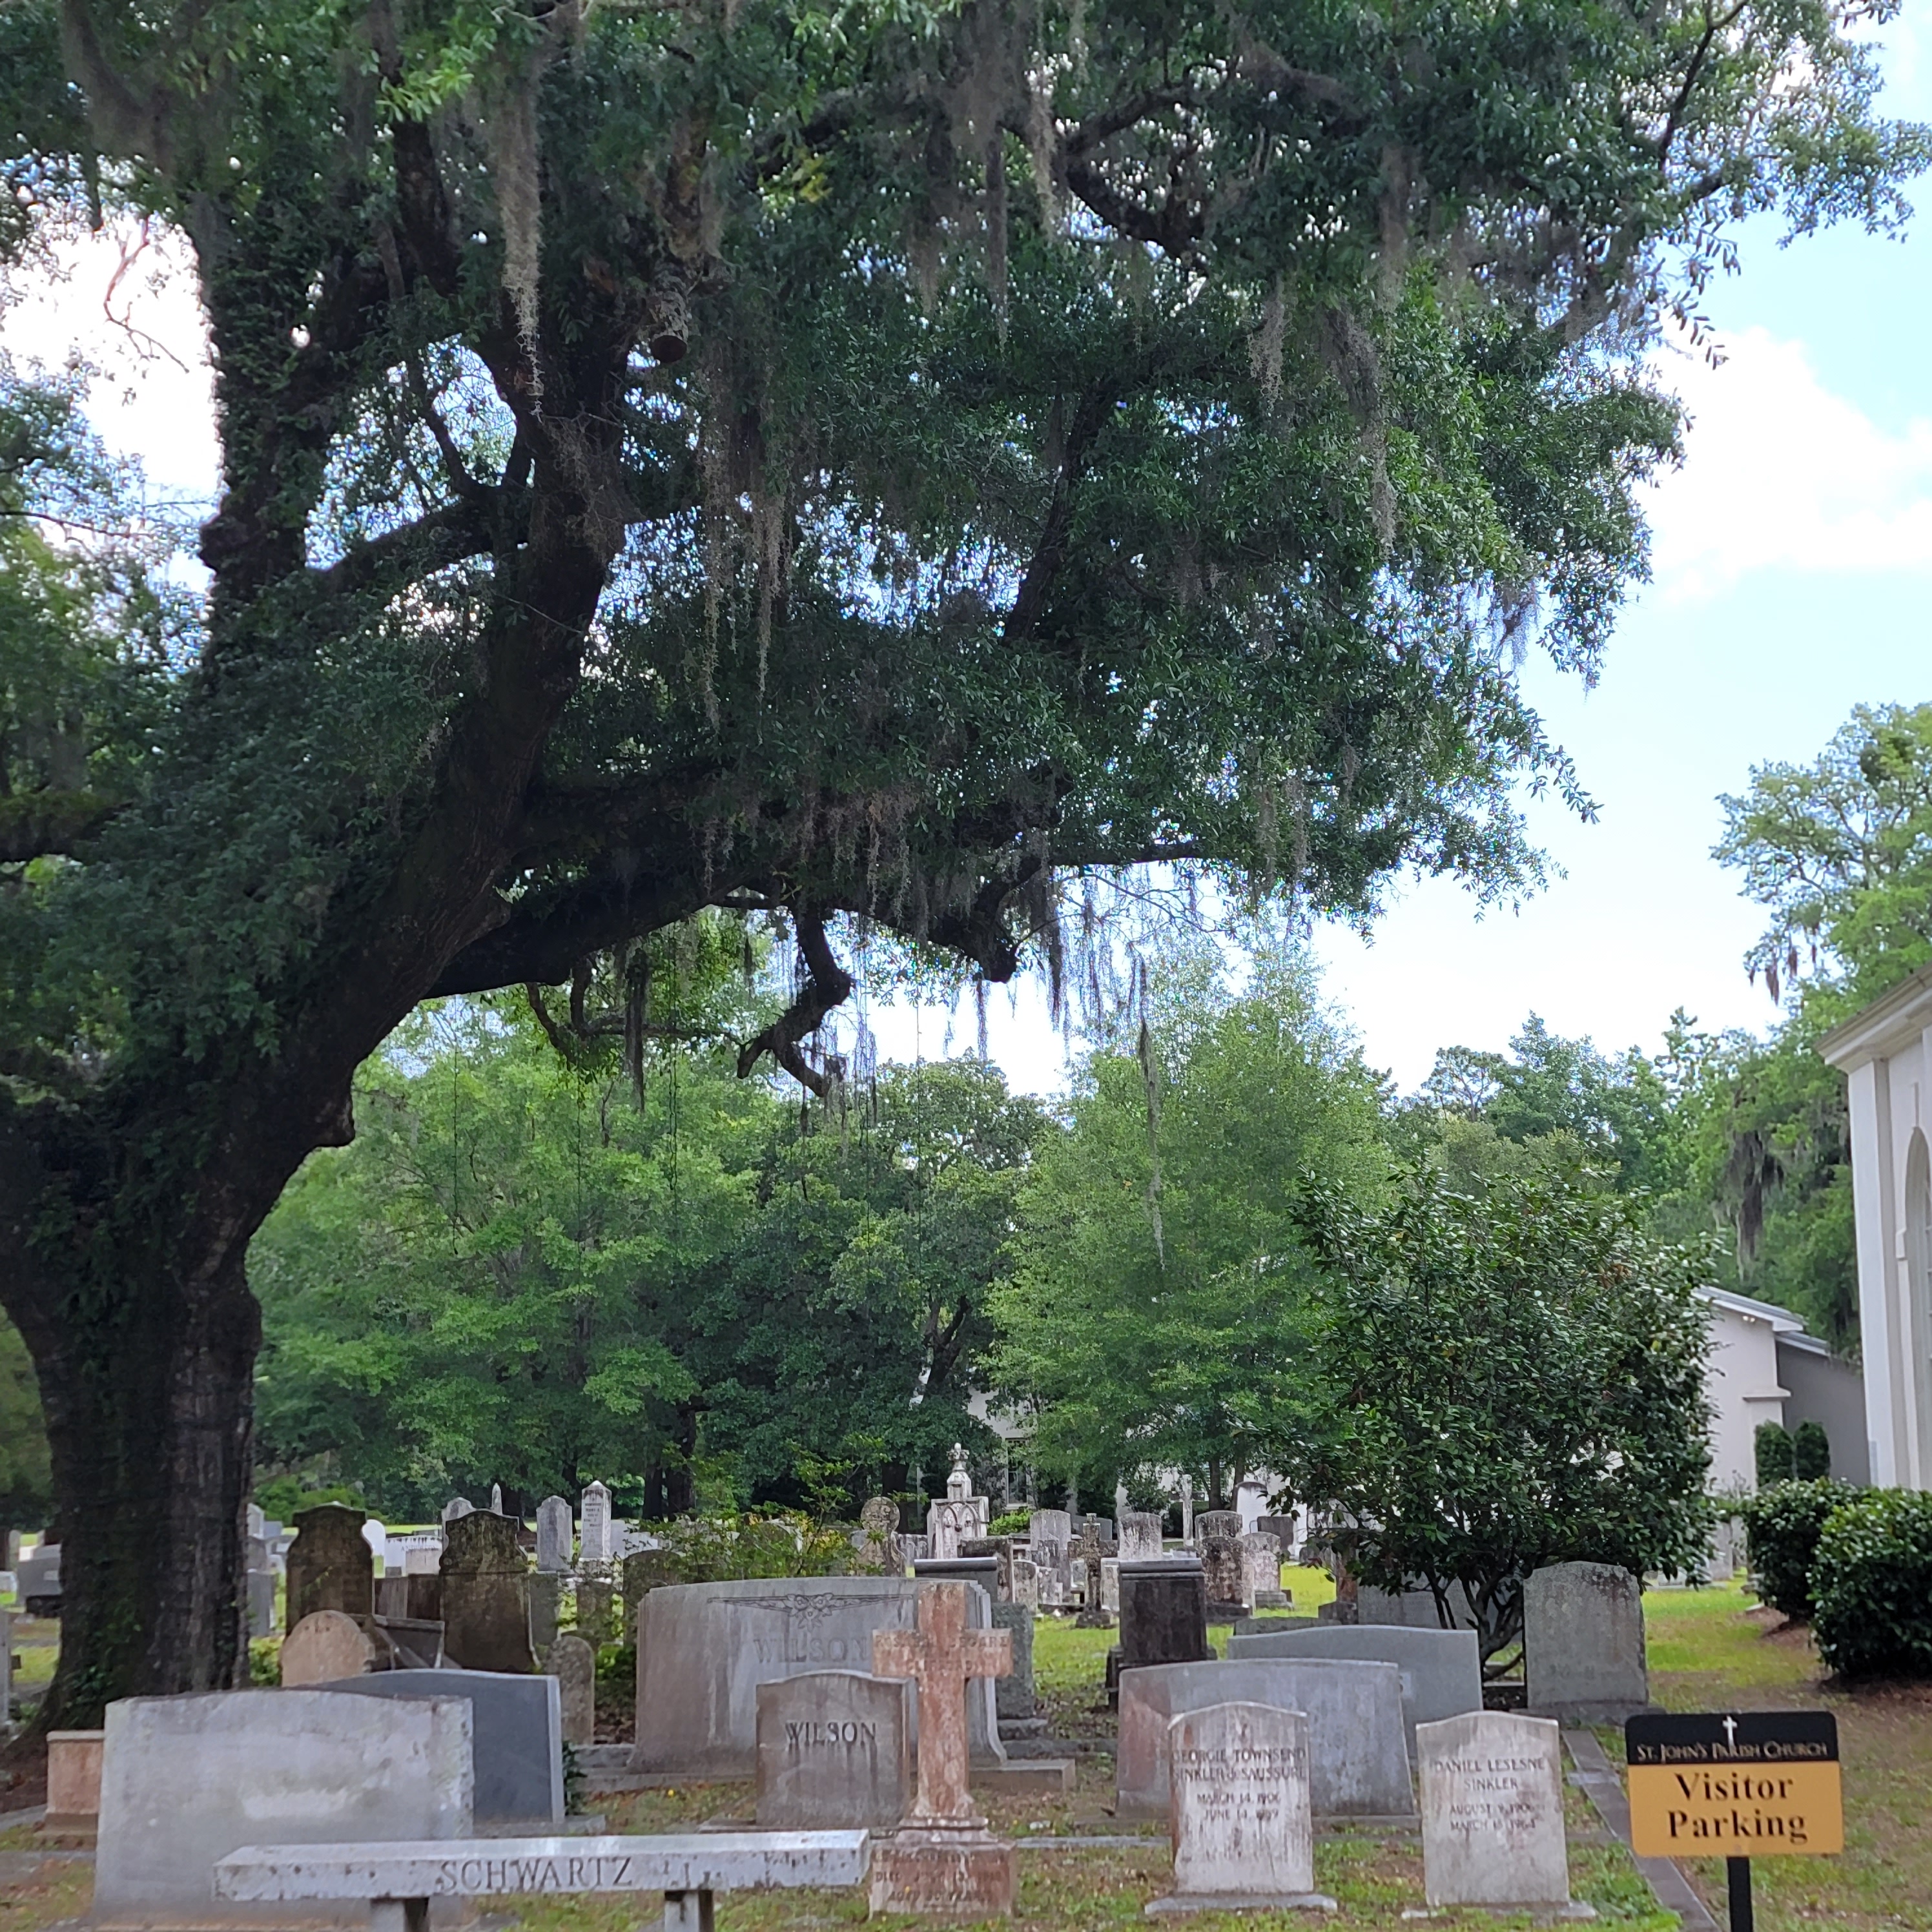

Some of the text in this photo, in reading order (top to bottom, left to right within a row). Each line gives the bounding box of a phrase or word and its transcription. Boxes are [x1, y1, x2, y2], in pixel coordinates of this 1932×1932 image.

[753, 1637, 869, 1663] WILSON
[785, 1721, 876, 1745] WILSON
[1233, 1747, 1306, 1762] TOWNSEND
[1712, 1742, 1760, 1760] PARISH
[1763, 1740, 1828, 1759] CHURCH
[1434, 1759, 1482, 1773] DANIEL
[1464, 1778, 1519, 1791] SINKLER
[1674, 1772, 1794, 1802] Visitor
[1205, 1809, 1229, 1821] JUNE
[1450, 1804, 1491, 1816] AUGUST
[1668, 1809, 1808, 1845] Parking
[440, 1856, 633, 1892] SCHWARTZ
